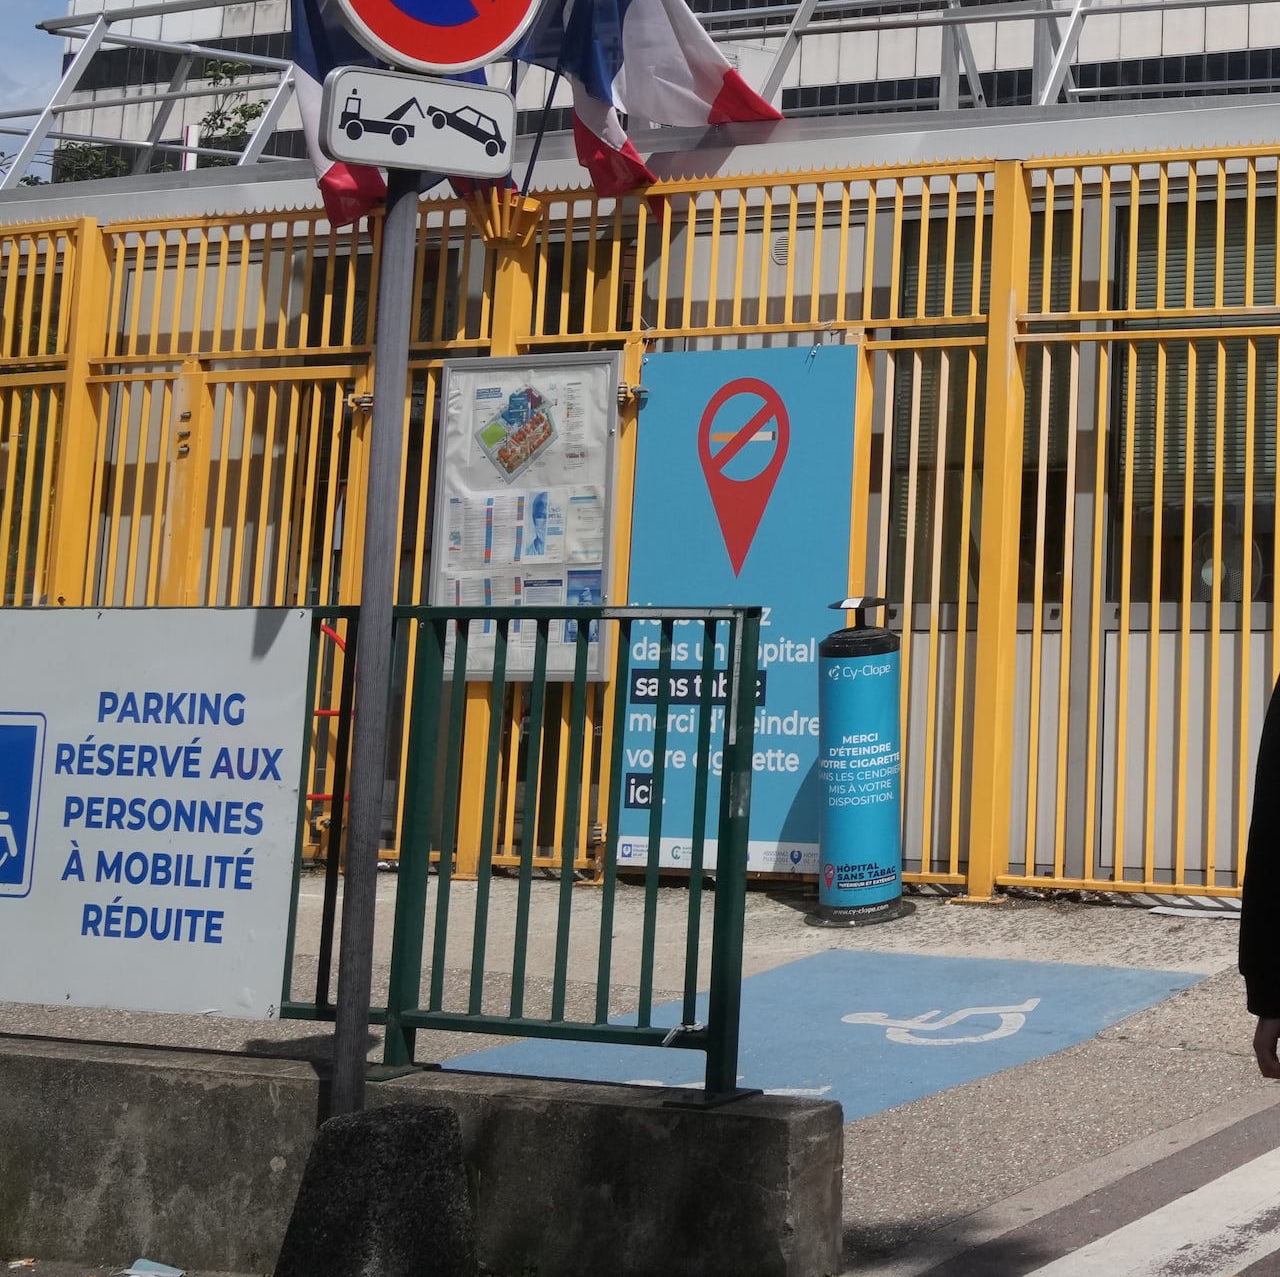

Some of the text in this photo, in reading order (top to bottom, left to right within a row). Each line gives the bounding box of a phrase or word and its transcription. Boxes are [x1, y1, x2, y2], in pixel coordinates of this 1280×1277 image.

[842, 664, 891, 680] Cy-Clope
[97, 690, 247, 725] PARKING
[842, 732, 879, 745] MERCI
[55, 734, 284, 781] RÉSERVÉ AUX
[835, 772, 855, 782] LES
[829, 784, 846, 794] MIS
[858, 779, 892, 793] VOTRE
[62, 795, 265, 836] PERSONNES
[61, 840, 255, 890] À MOBILITÉ
[836, 862, 879, 873] HÔPITAL
[837, 866, 896, 881] SANS TABAC
[80, 895, 225, 944] RÉDUITE
